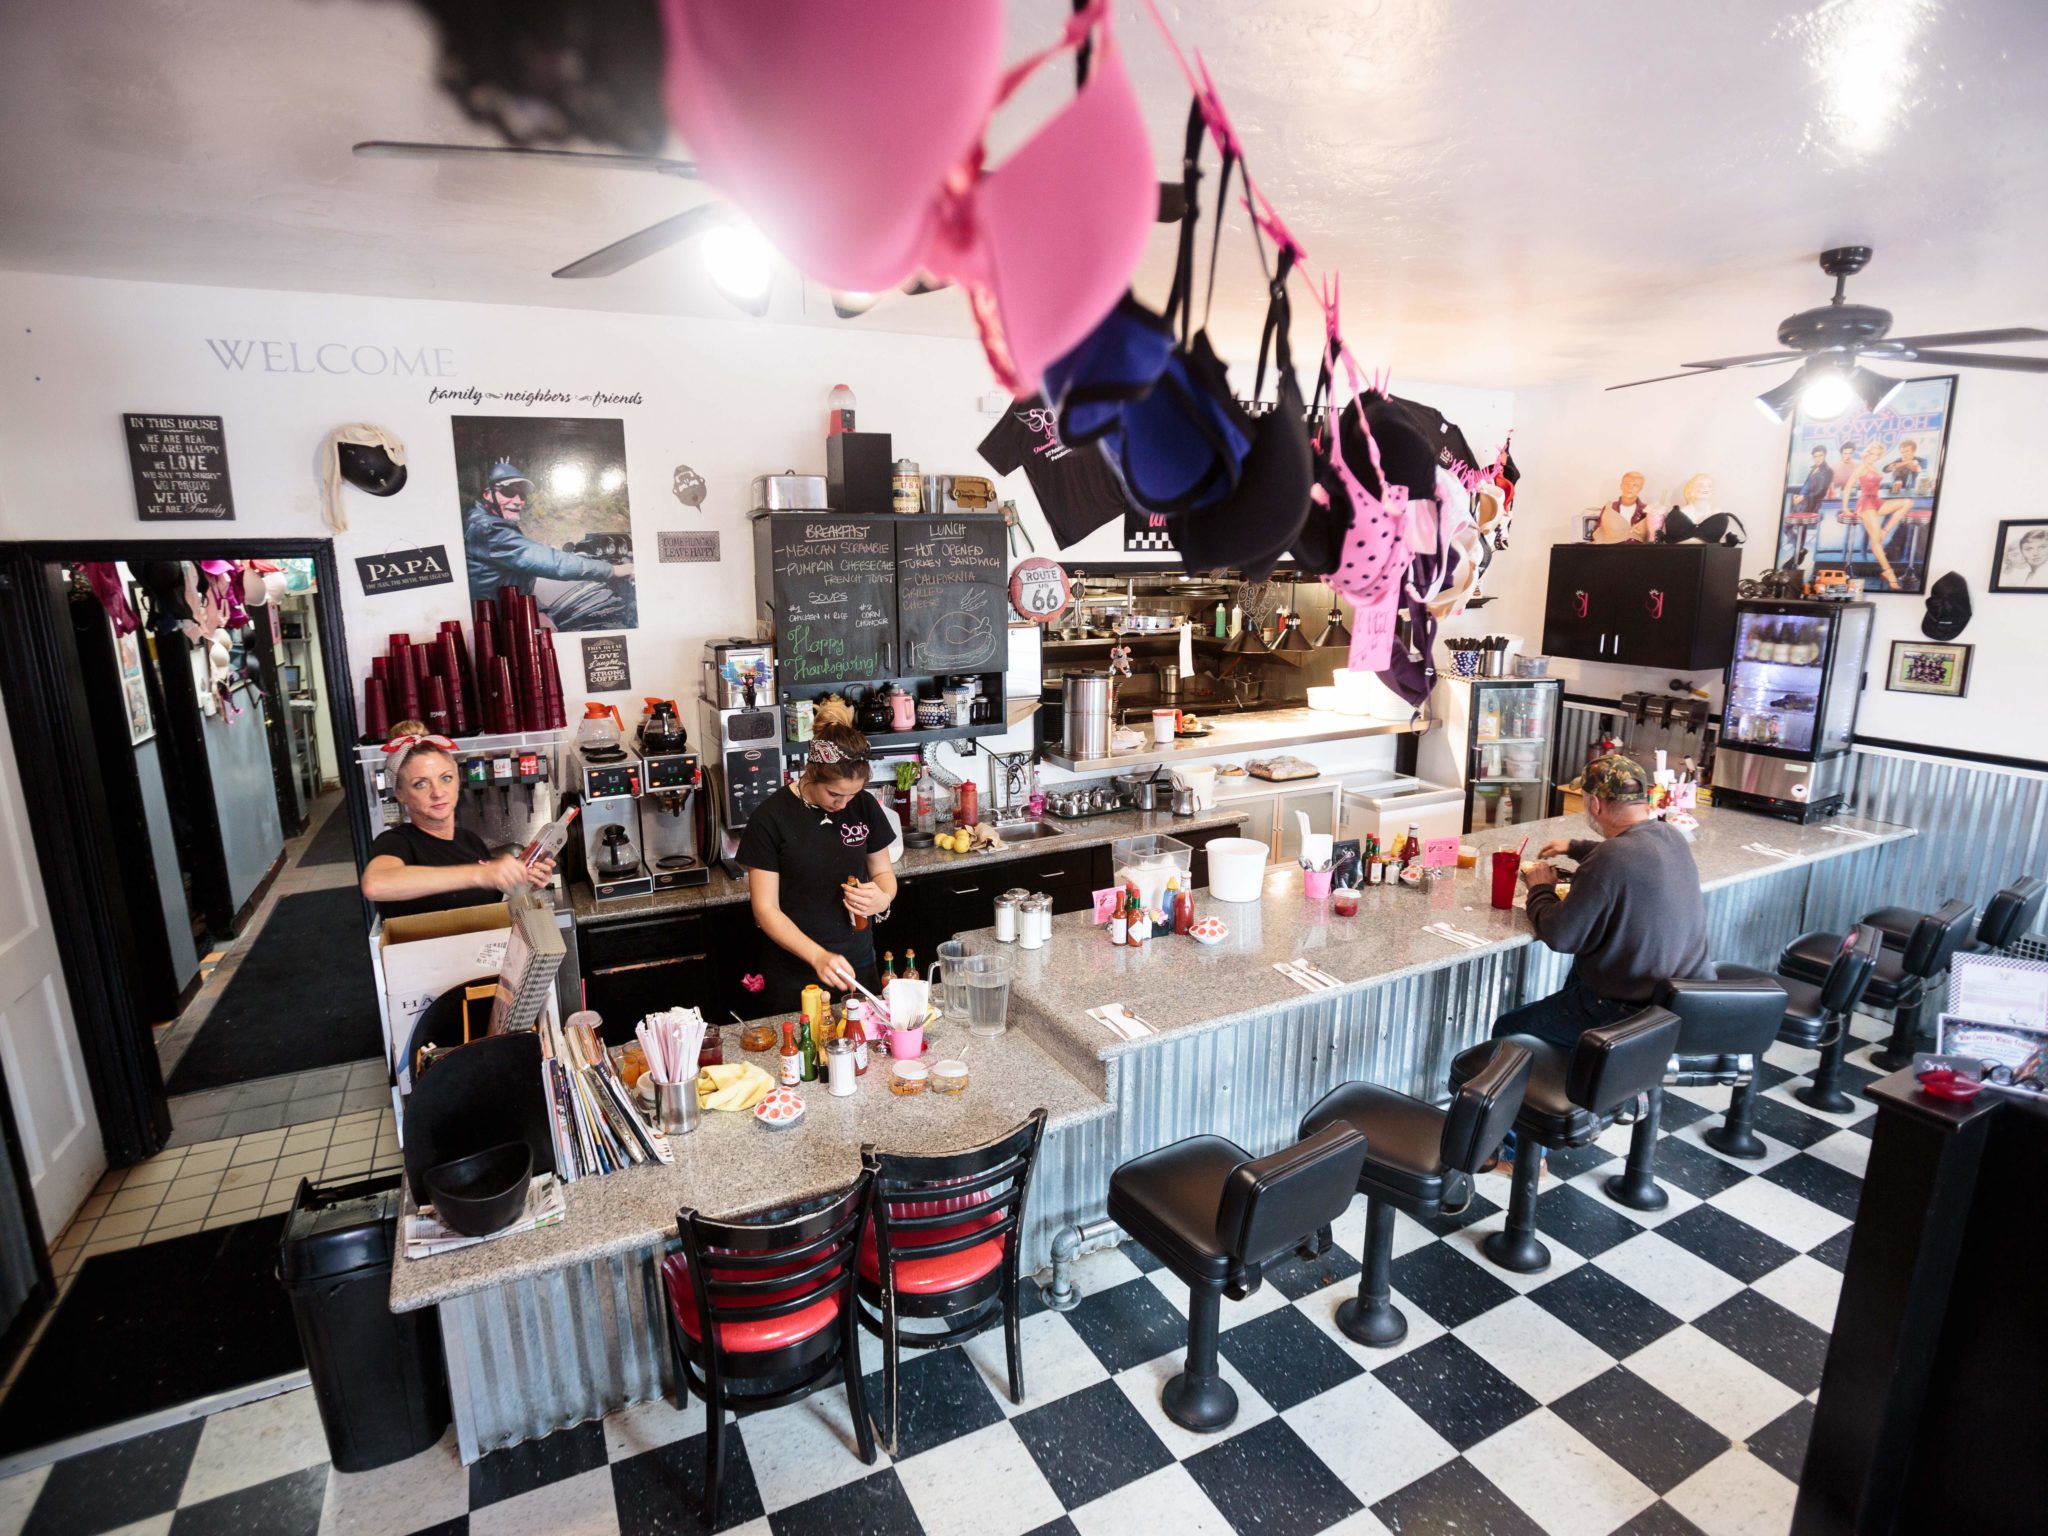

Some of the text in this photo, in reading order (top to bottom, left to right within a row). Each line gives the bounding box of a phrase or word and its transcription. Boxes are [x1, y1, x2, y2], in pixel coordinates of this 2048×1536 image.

[205, 338, 458, 378] WELCOME
[428, 385, 643, 408] family neighbors friends
[130, 417, 218, 431] IN THIS HOUSE
[164, 434, 181, 444] ARE
[140, 444, 220, 454] WE ARE HAPPY
[169, 455, 208, 471] LOVE
[154, 492, 208, 504] WE HUG
[147, 503, 226, 518] WE ARE Family
[805, 523, 870, 539] BREAKFAST
[929, 521, 967, 537] LUNCH
[664, 546, 714, 557] LEAVE HAPPY
[786, 541, 890, 557] MEXICAN SCRAMBLE
[914, 542, 984, 557] HOT OPENED
[366, 556, 443, 582] PAPA
[787, 560, 834, 576] PUMPKIN
[900, 556, 1000, 569] TURKEY SANDWICH
[823, 573, 894, 587] FRENCH TOAST
[914, 571, 976, 586] CALIFORNIA
[1026, 570, 1057, 581] ROUTE
[808, 592, 848, 602] SOUPS
[902, 586, 944, 599] GRILLED
[1032, 587, 1058, 611] 66
[861, 608, 880, 619] CORN
[787, 625, 844, 656] Happy
[593, 652, 620, 660] LOVE
[784, 654, 878, 681] Thanksgiving!
